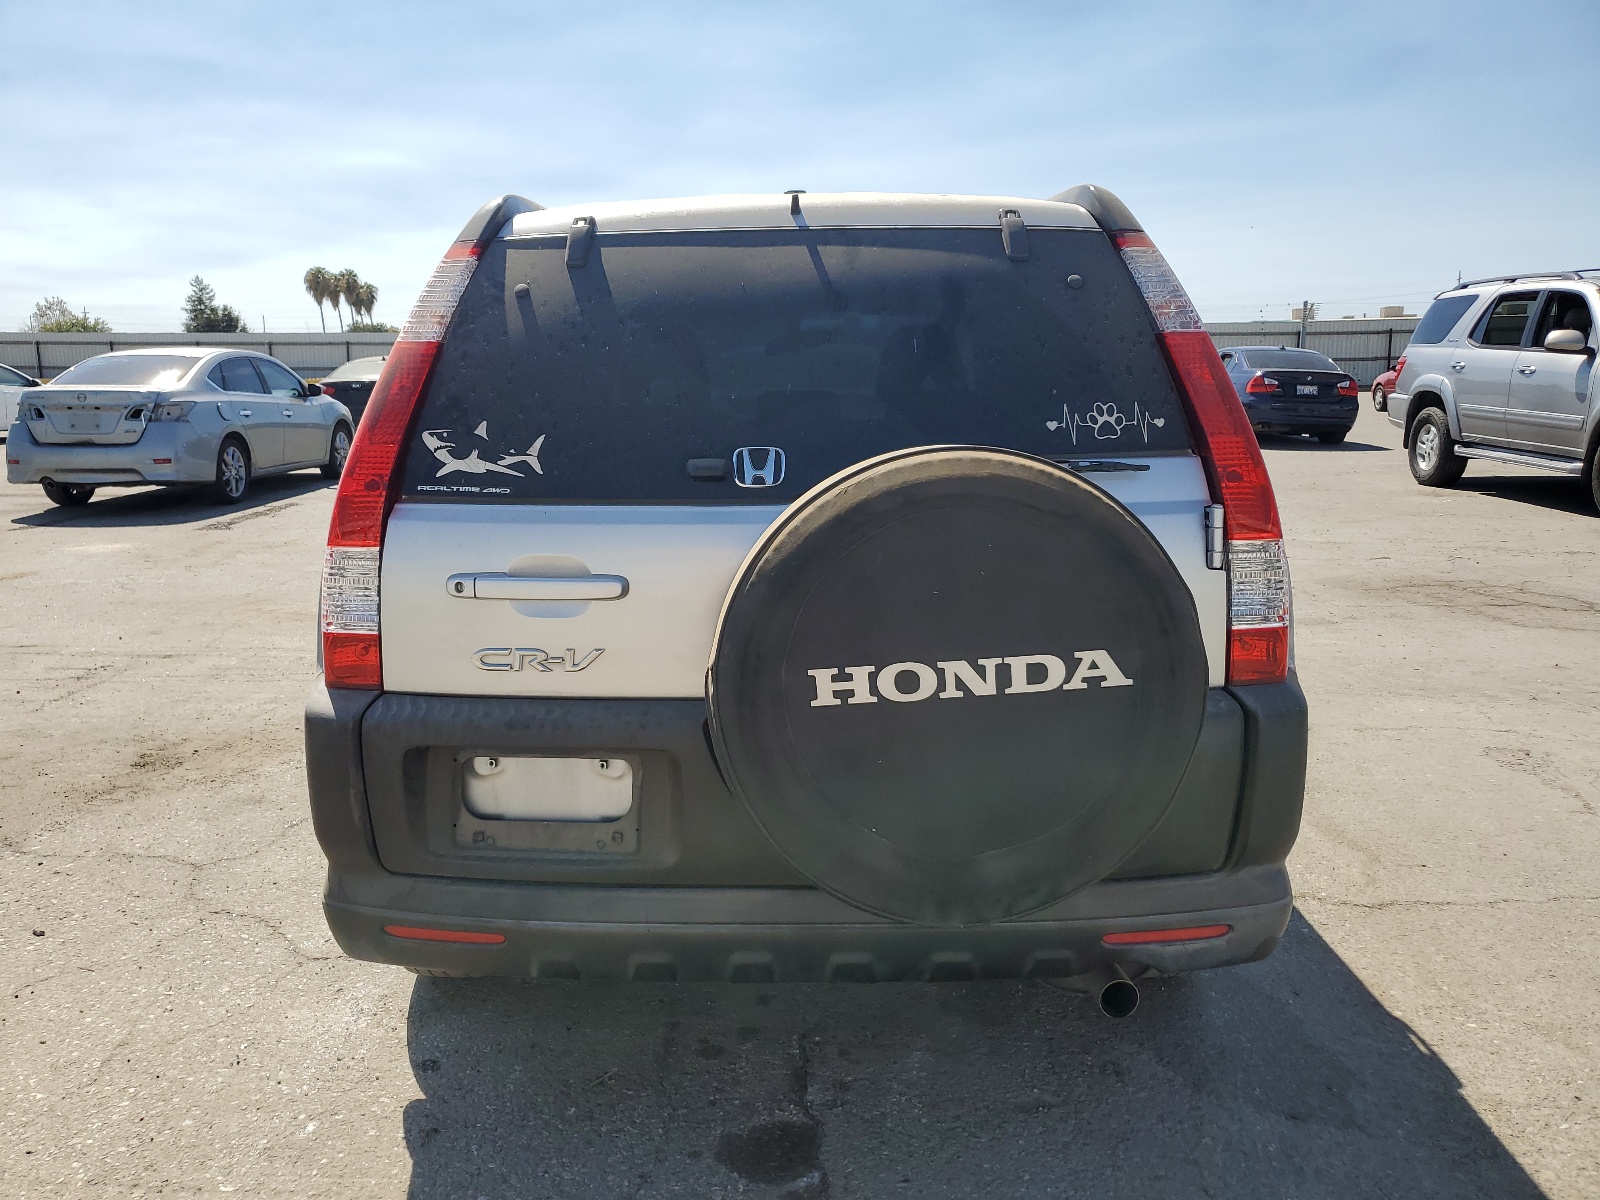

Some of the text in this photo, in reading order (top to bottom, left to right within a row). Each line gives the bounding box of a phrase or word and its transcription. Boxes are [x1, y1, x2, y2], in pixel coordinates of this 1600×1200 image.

[417, 485, 481, 493] REALTIME
[471, 647, 606, 672] CR-V
[807, 649, 1134, 707] HONDA
